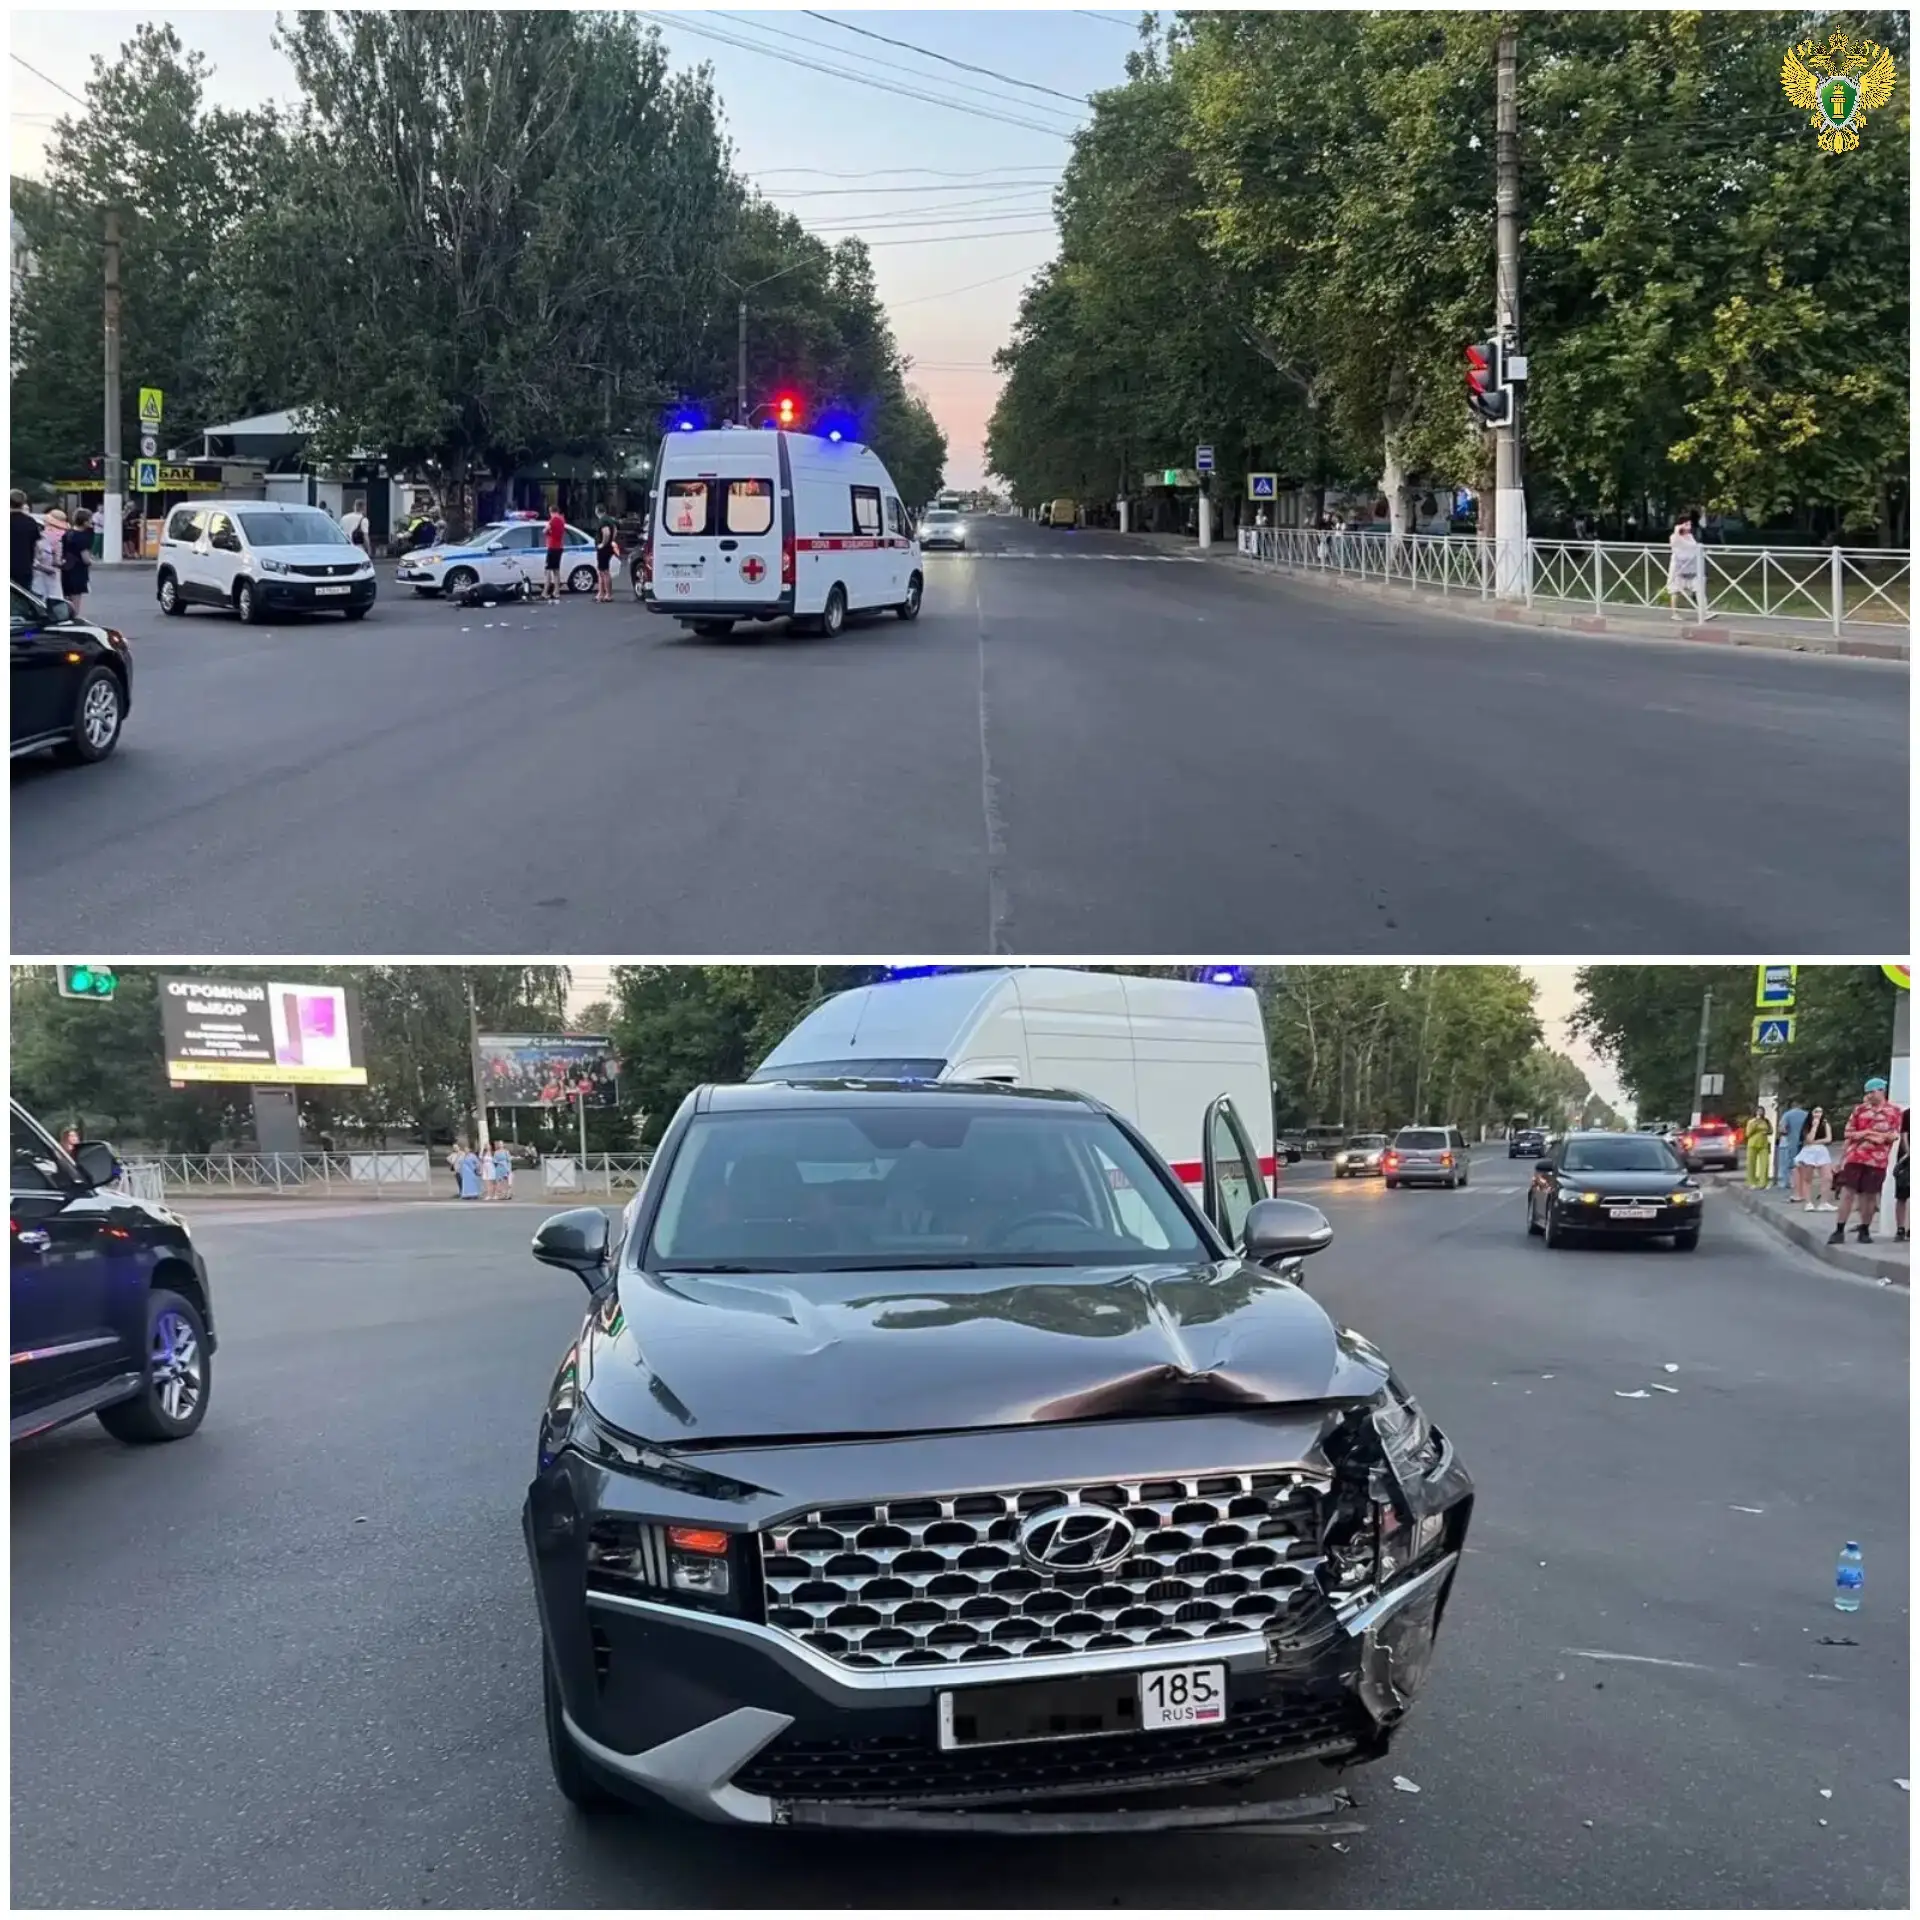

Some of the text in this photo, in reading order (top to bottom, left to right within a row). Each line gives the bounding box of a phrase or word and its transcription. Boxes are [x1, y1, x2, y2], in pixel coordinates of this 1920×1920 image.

[159, 468, 191, 480] БАК
[675, 582, 691, 594] 100
[167, 982, 265, 1001] ОГРОМНЫЙ
[186, 1000, 248, 1016] ВЫБОР
[1148, 1670, 1212, 1708] 185
[1162, 1707, 1194, 1721] RUS
